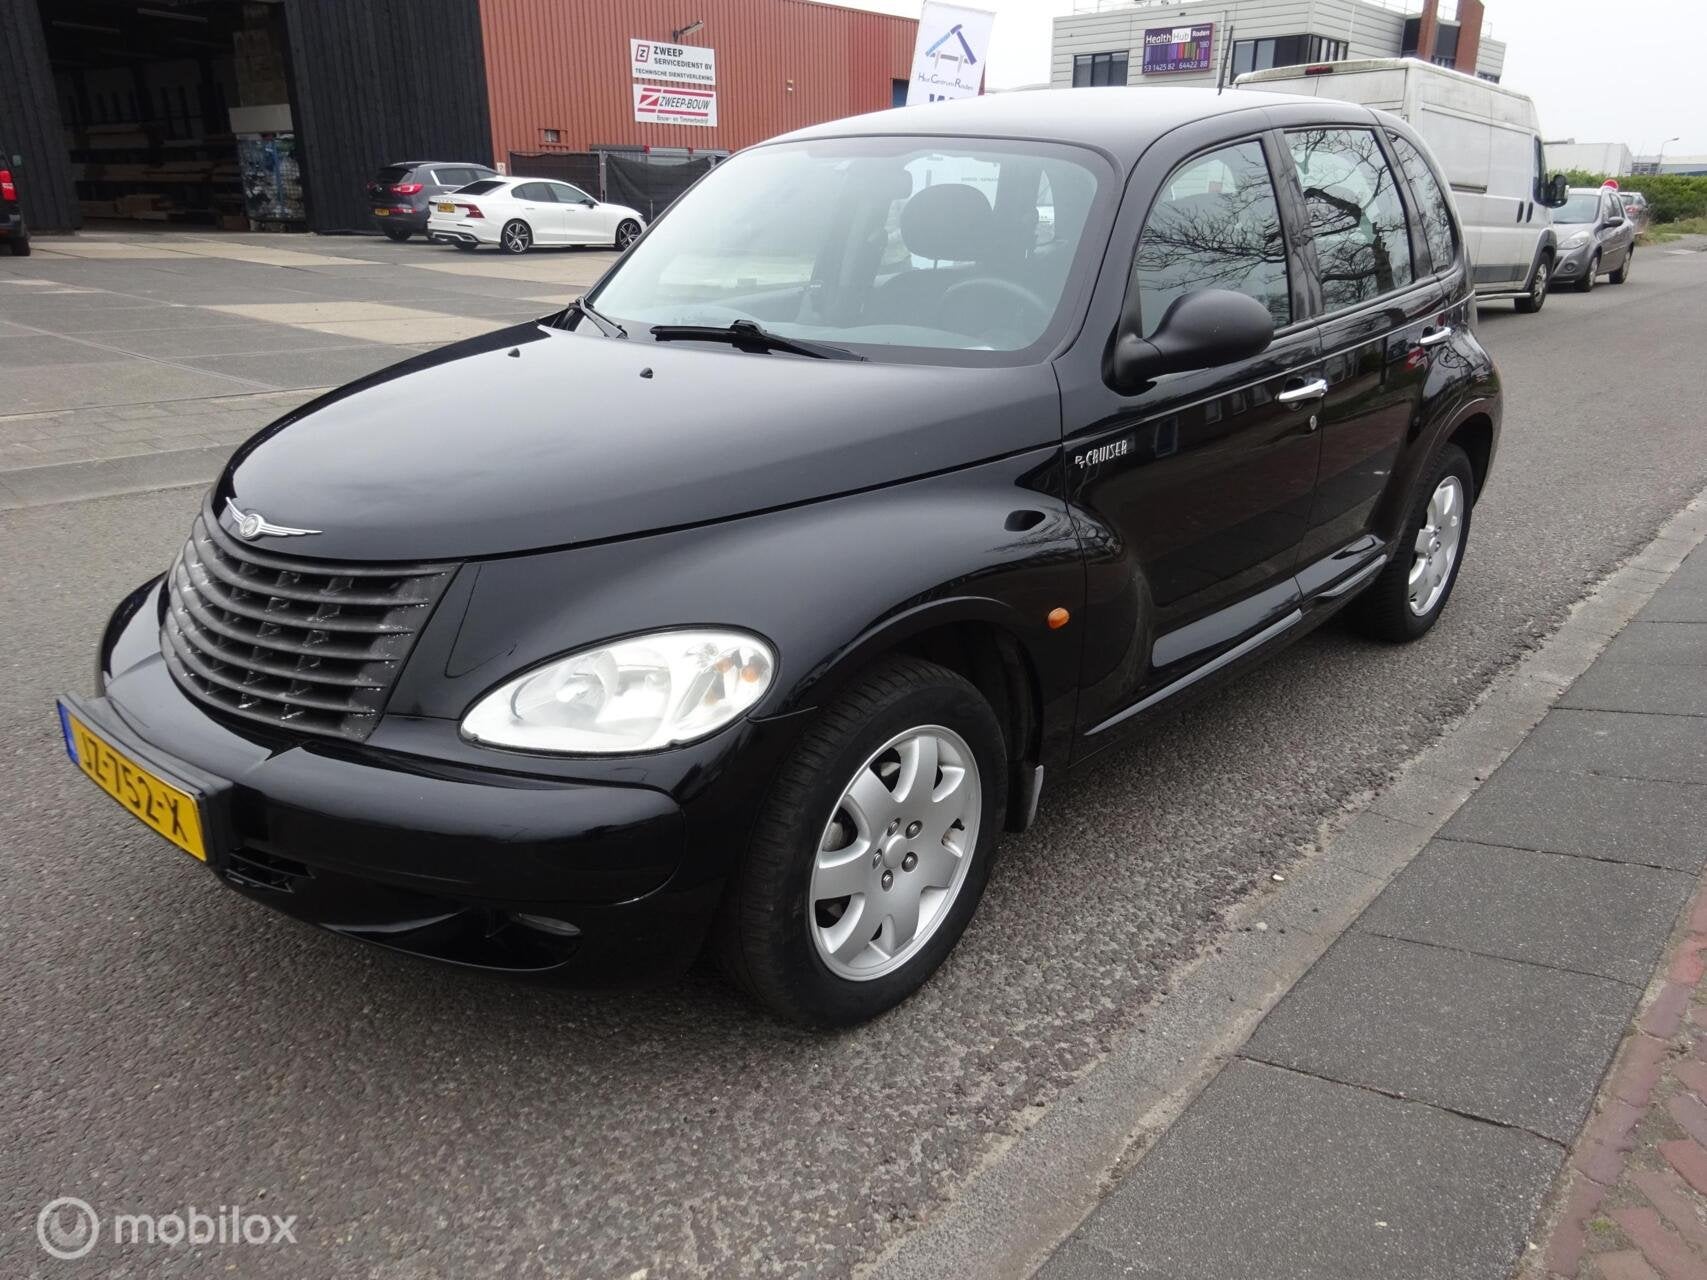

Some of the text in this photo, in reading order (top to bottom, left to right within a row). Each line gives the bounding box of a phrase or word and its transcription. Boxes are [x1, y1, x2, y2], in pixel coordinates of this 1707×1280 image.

[1146, 33, 1172, 44] Health
[1173, 32, 1189, 41] Hub
[653, 46, 683, 57] ZWEEP
[653, 57, 713, 71] SERVICEDIENST BV
[635, 68, 713, 81] TECHNISCHE DIENSTVERLENING
[659, 96, 711, 110] ZWEEP-BOUW
[1085, 439, 1128, 466] CRUISER
